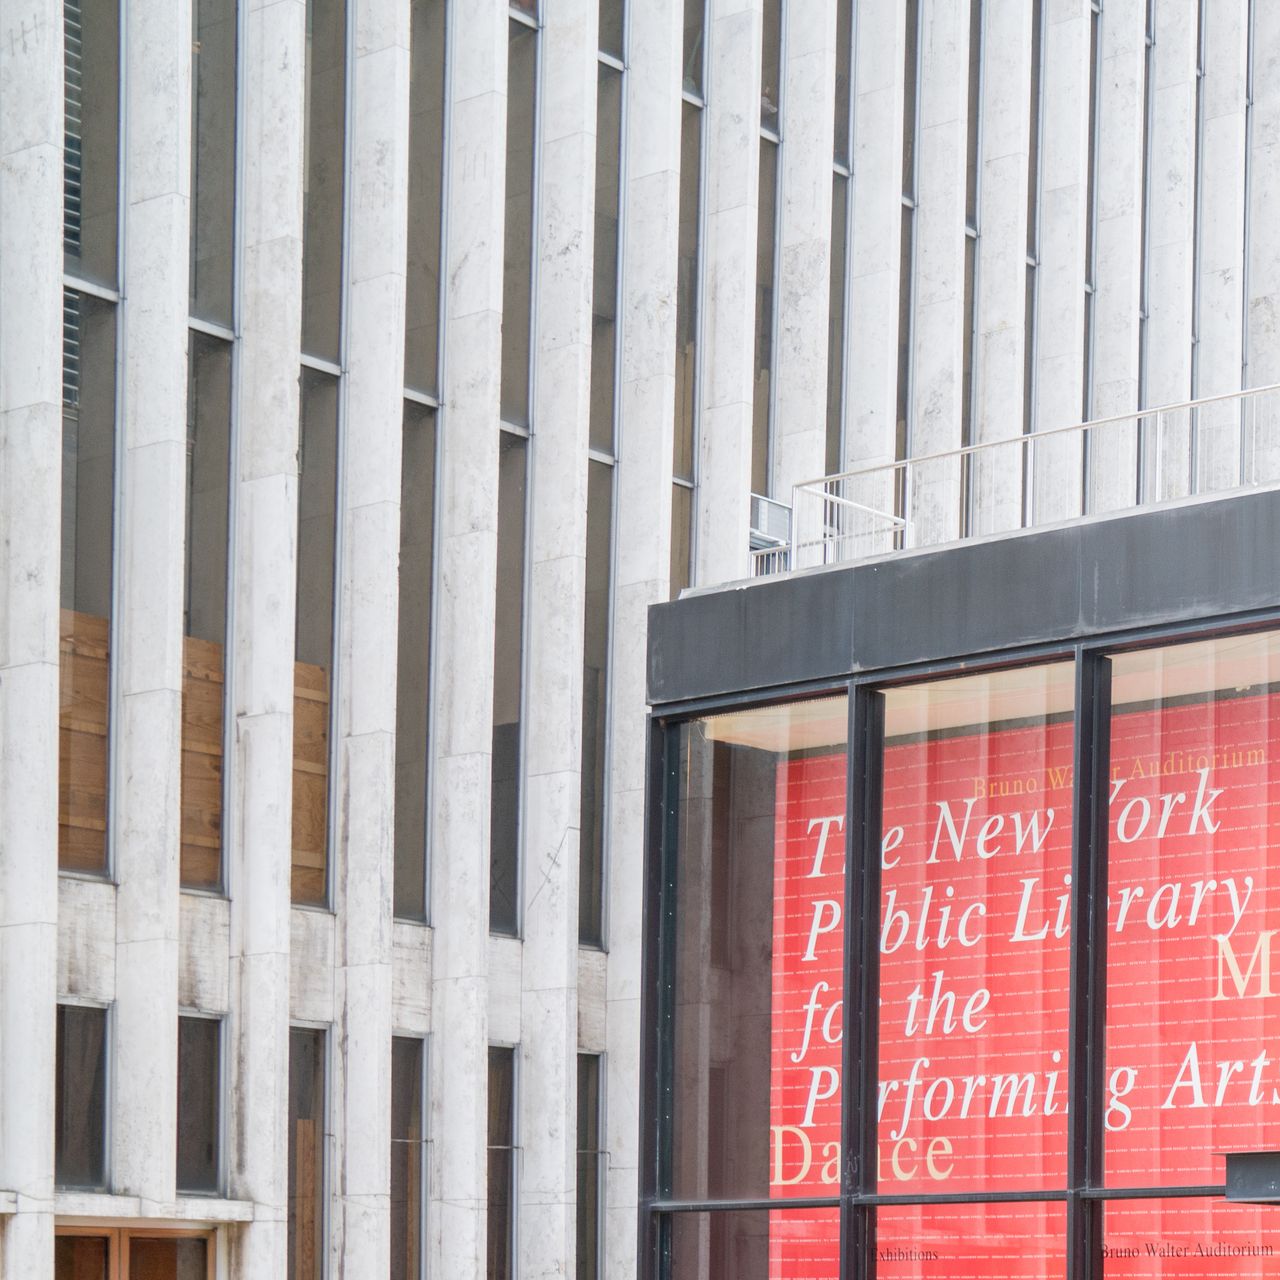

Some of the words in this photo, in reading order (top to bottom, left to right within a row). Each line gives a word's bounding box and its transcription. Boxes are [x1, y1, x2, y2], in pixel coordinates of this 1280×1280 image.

[973, 778, 1037, 800] Bruno
[1131, 746, 1265, 780] Auditorium
[806, 815, 904, 879] Te
[926, 798, 1055, 865] New
[801, 886, 986, 962] Pblic
[1009, 873, 1254, 942] Lirary
[791, 980, 882, 1062] fo
[906, 971, 991, 1037] the
[802, 1050, 1138, 1141] Prformig
[770, 1125, 955, 1186] Dace
[1144, 1241, 1190, 1258] Walter
[1197, 1240, 1274, 1258] Auditorium
